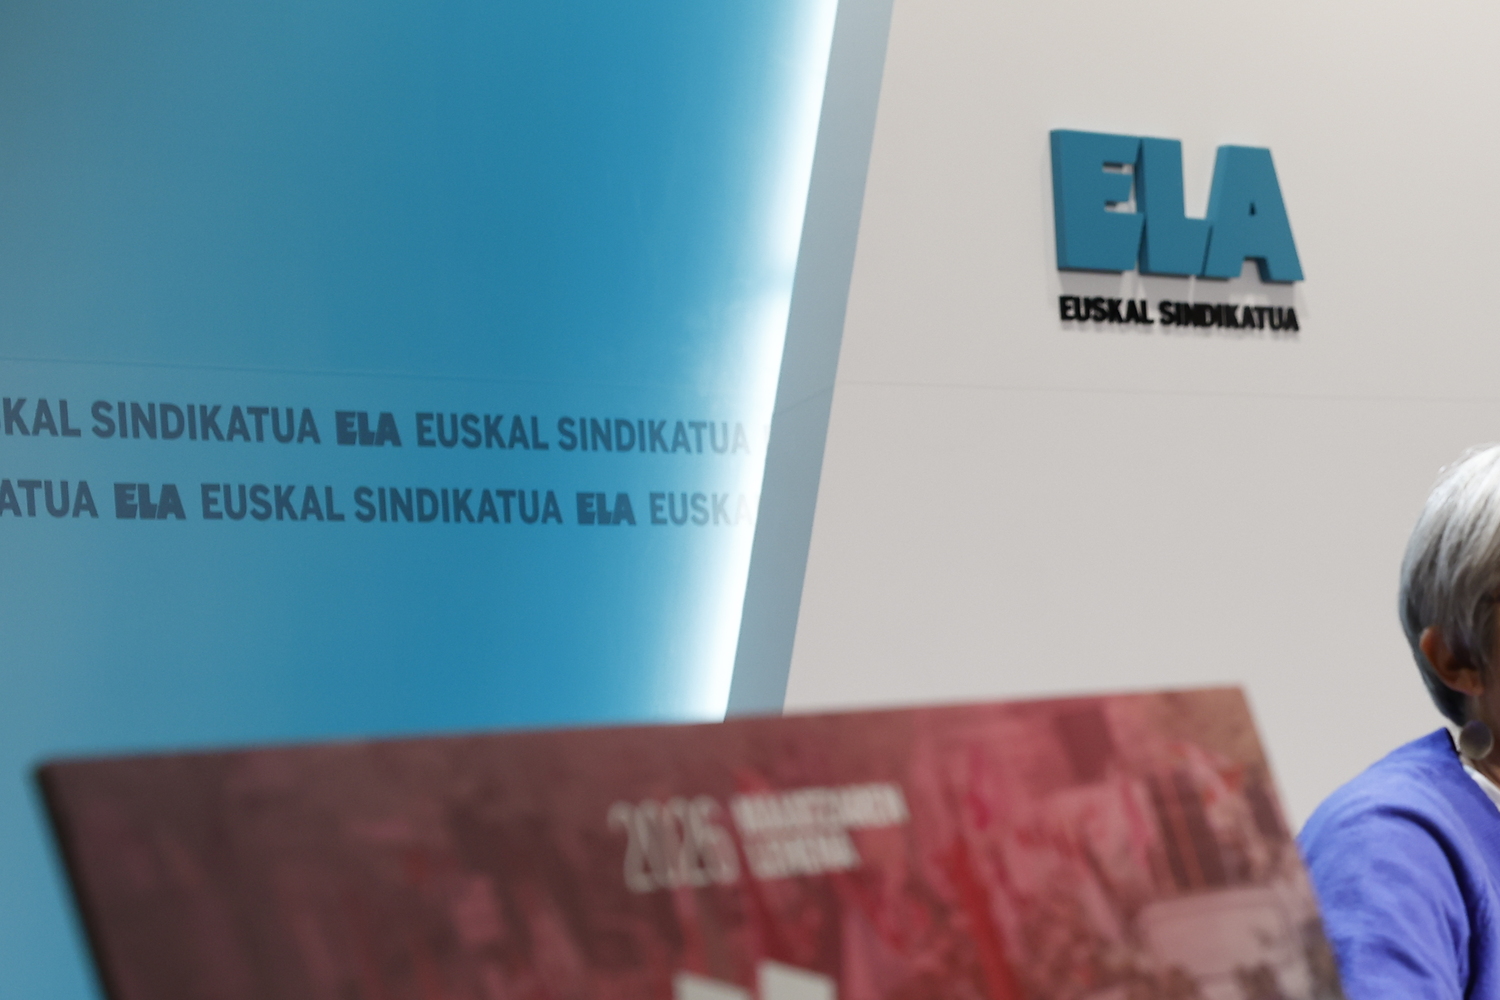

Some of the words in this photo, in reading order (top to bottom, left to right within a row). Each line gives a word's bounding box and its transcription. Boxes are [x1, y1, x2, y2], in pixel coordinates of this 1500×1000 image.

[1049, 129, 1304, 283] ELA
[1059, 296, 1154, 326] EUSKAL
[1158, 301, 1300, 332] SINDIKATUA
[0, 398, 81, 437] KAL
[91, 401, 321, 444] SINDIKATUA
[335, 411, 402, 446] ELA
[416, 412, 549, 450] EUSKAL
[557, 416, 751, 454] SINDIKATUA
[113, 483, 186, 520] ELA
[201, 483, 345, 522] EUSKAL
[353, 486, 563, 524] SINDIKATUA
[576, 492, 637, 525] ELA
[650, 492, 759, 525] EUSKA
